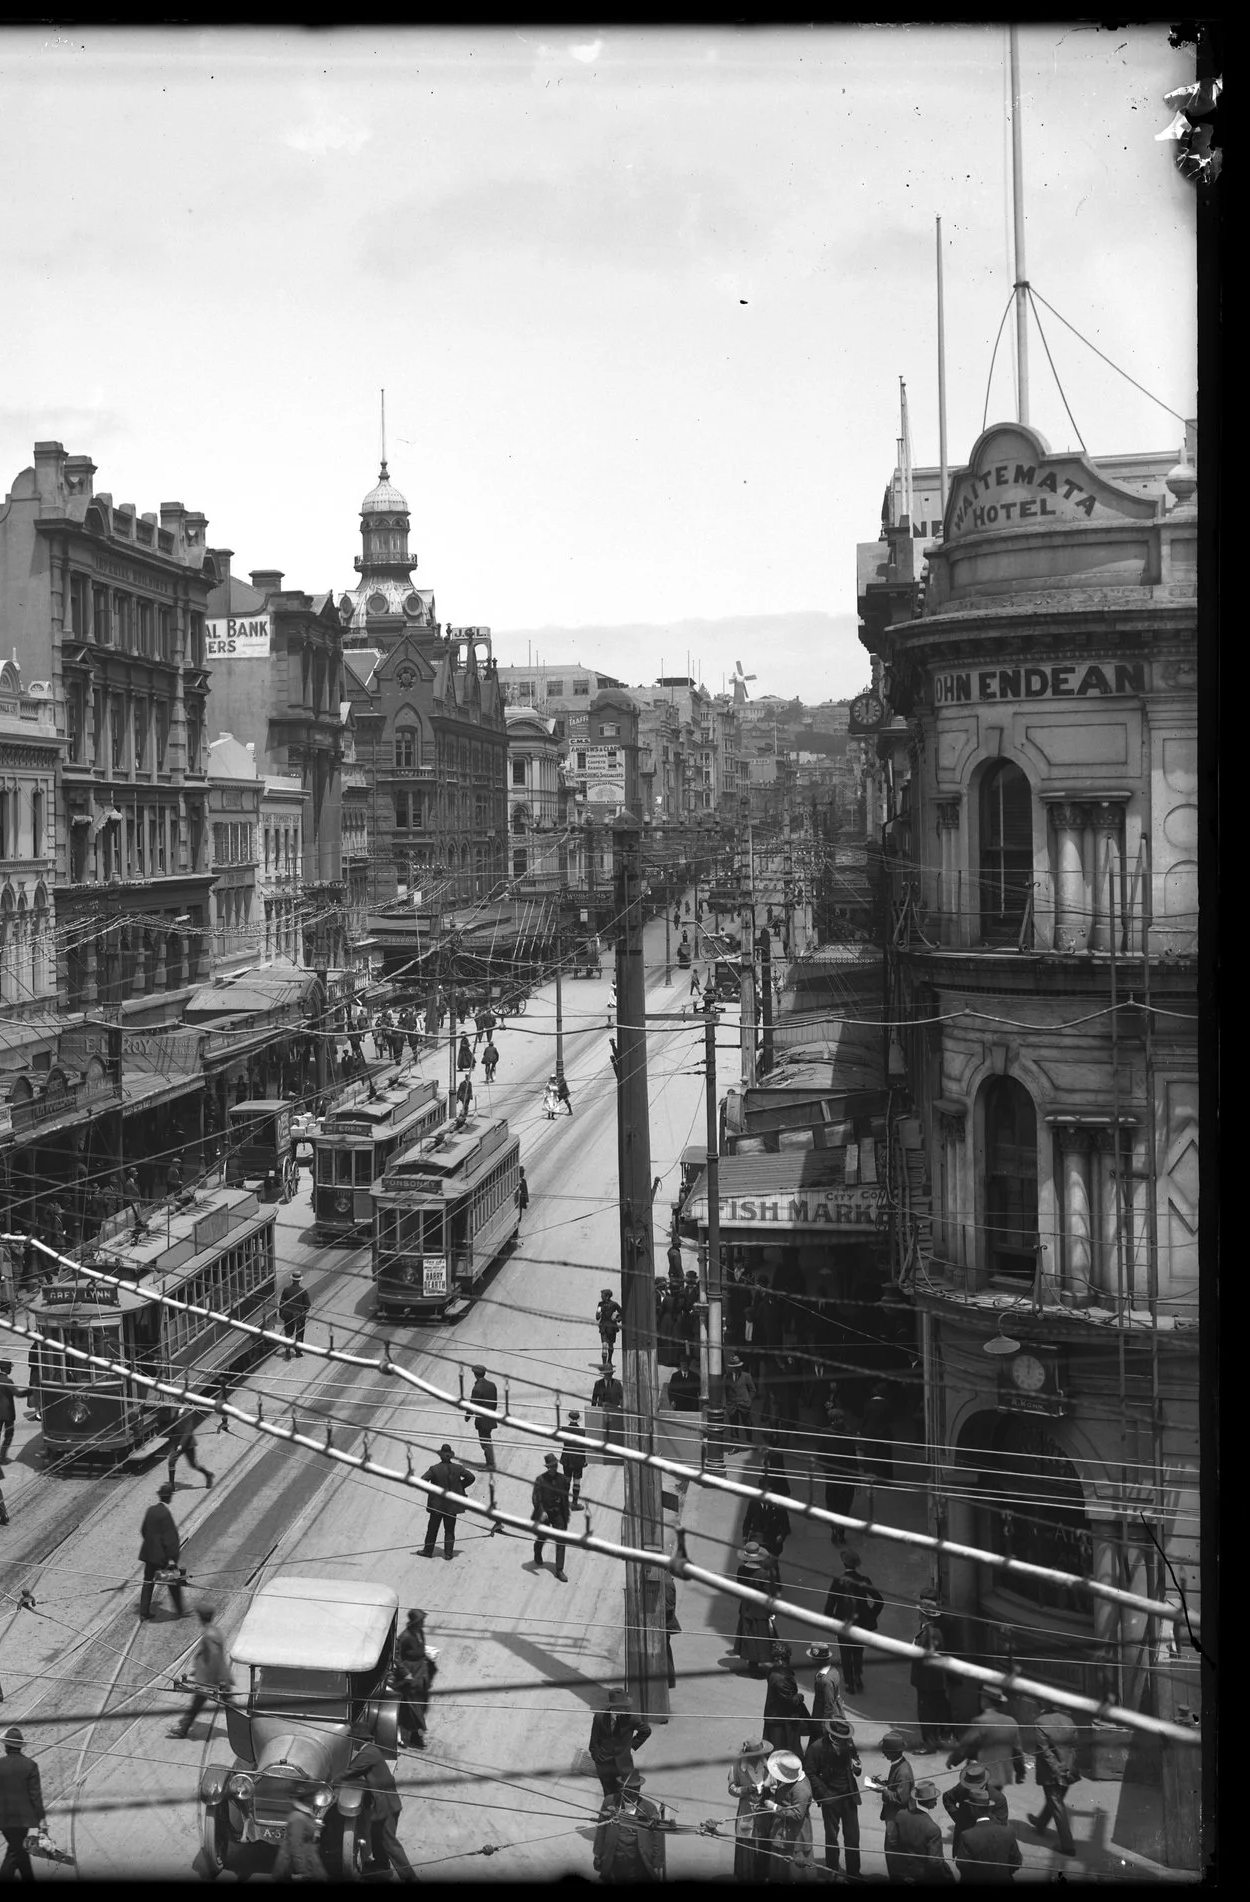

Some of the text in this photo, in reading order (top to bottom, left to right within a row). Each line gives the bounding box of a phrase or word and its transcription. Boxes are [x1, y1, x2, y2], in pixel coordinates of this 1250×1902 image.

[954, 464, 1097, 531] WAITEMATA
[973, 497, 1057, 529] HOTEL
[227, 618, 268, 638] BANK
[935, 664, 1146, 702] OHN ENDEAN
[825, 1191, 855, 1202] CITY
[84, 1290, 111, 1299] LYNN
